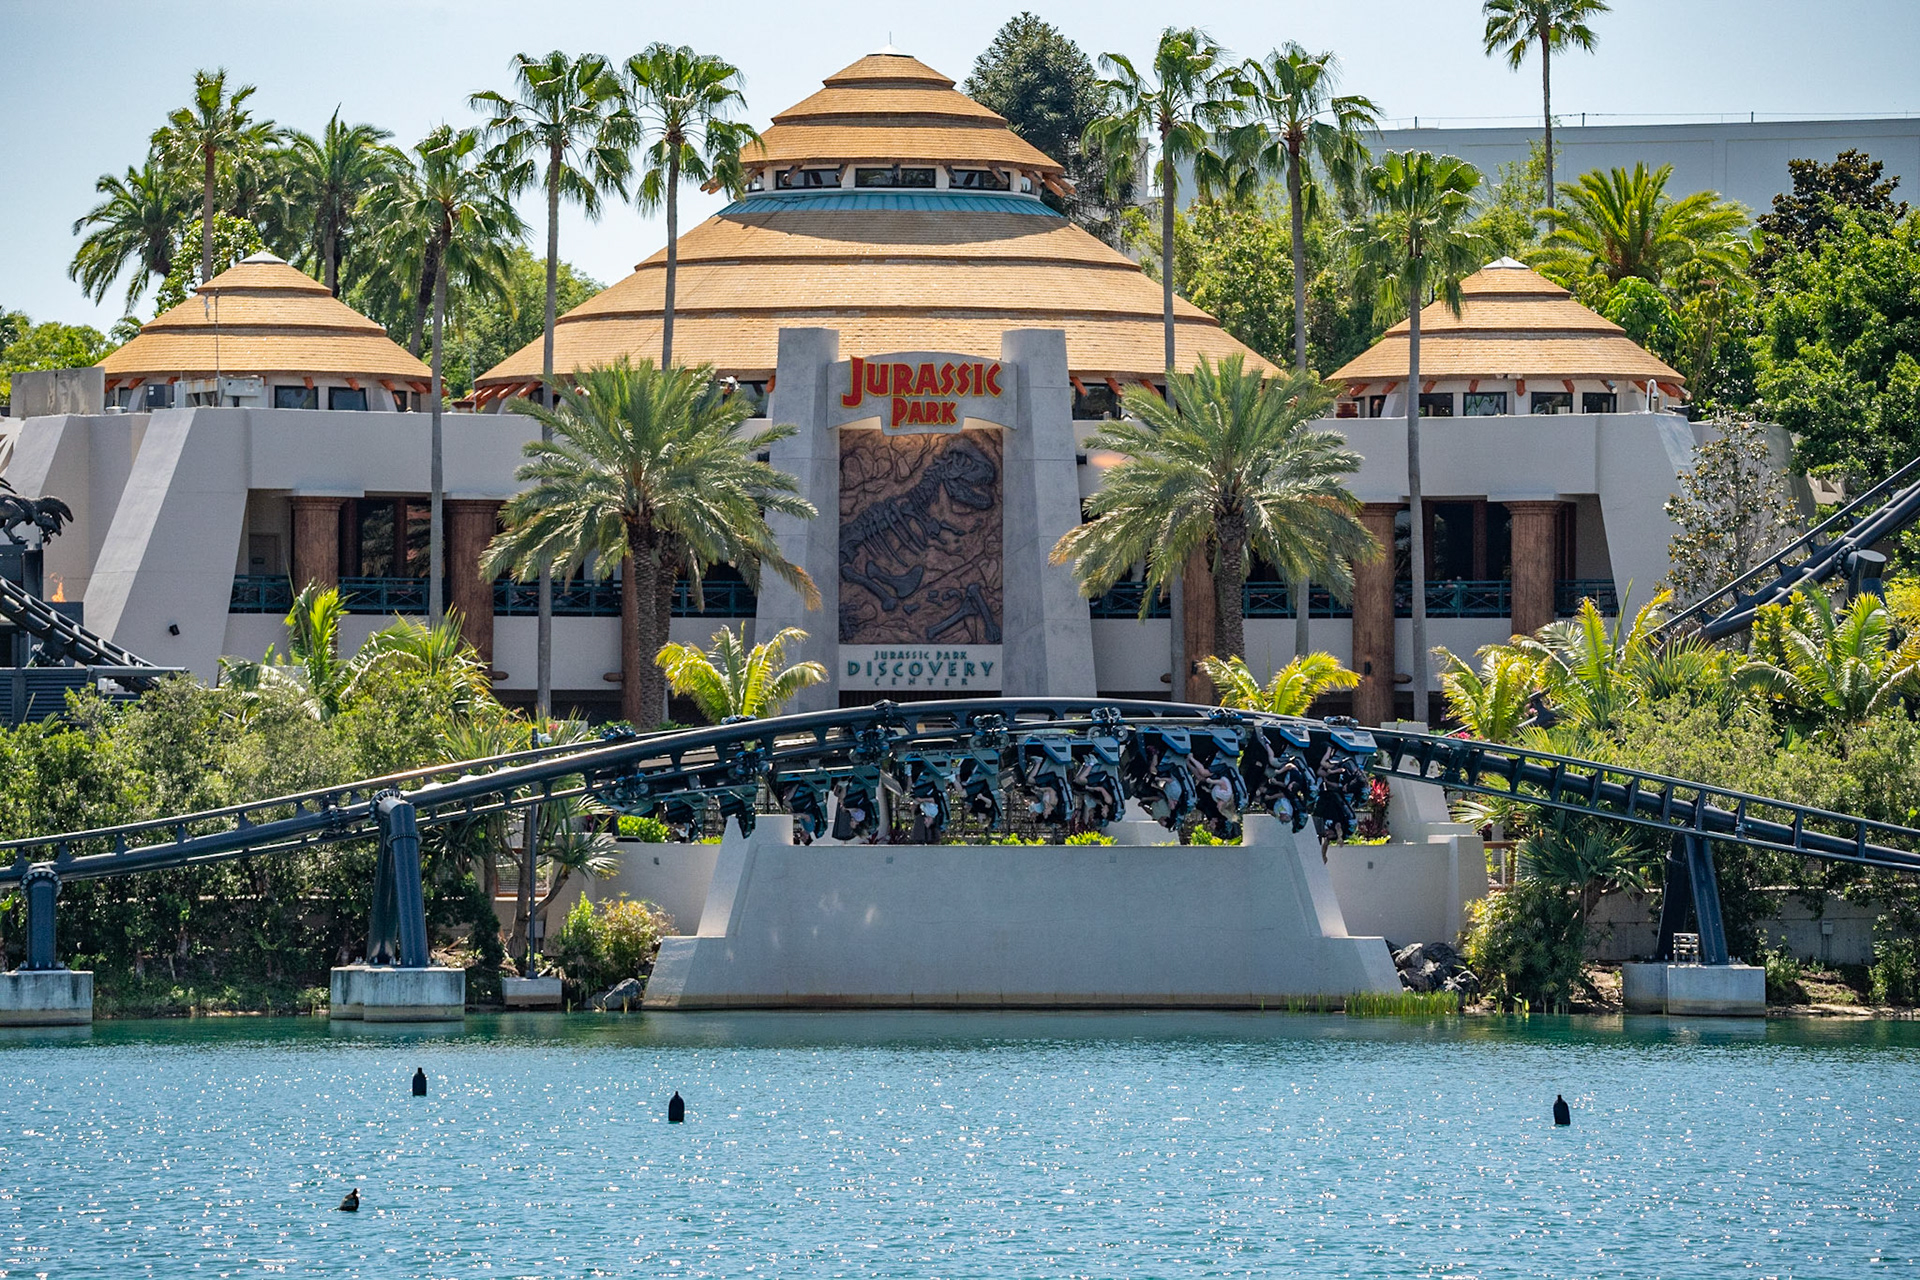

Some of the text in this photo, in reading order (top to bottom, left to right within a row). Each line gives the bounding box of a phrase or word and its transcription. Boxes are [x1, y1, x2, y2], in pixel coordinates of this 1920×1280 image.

[841, 355, 1003, 408] JURASSIC
[890, 396, 958, 428] PARK
[874, 650, 968, 660] JURASSIC PARK
[847, 661, 994, 677] DISCOVERY
[874, 677, 968, 686] CENTER
